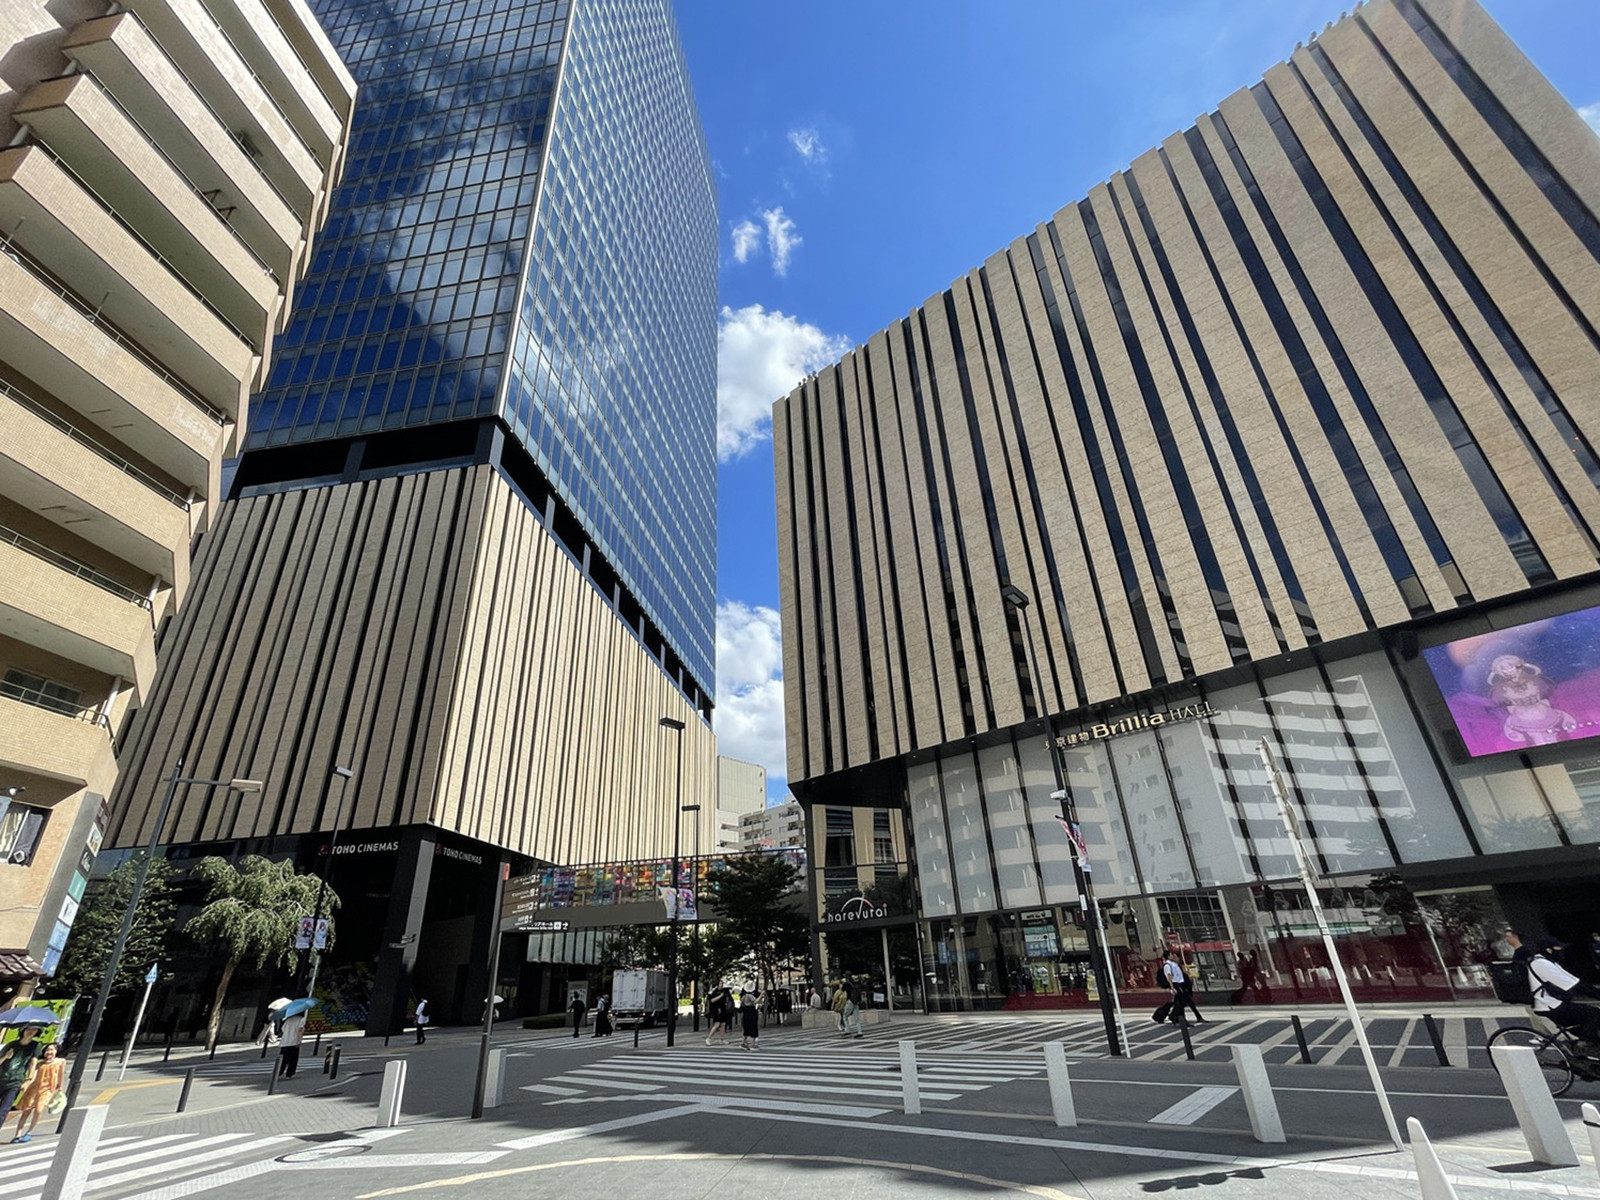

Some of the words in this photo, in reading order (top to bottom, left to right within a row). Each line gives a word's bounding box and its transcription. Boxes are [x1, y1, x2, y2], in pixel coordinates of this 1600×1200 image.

[1091, 713, 1165, 739] Brillia
[1170, 702, 1217, 720] HALL
[331, 844, 355, 855] TOHO
[357, 841, 399, 853] CINEMAS
[443, 847, 459, 859] TOHO
[458, 851, 483, 865] CINEMAS
